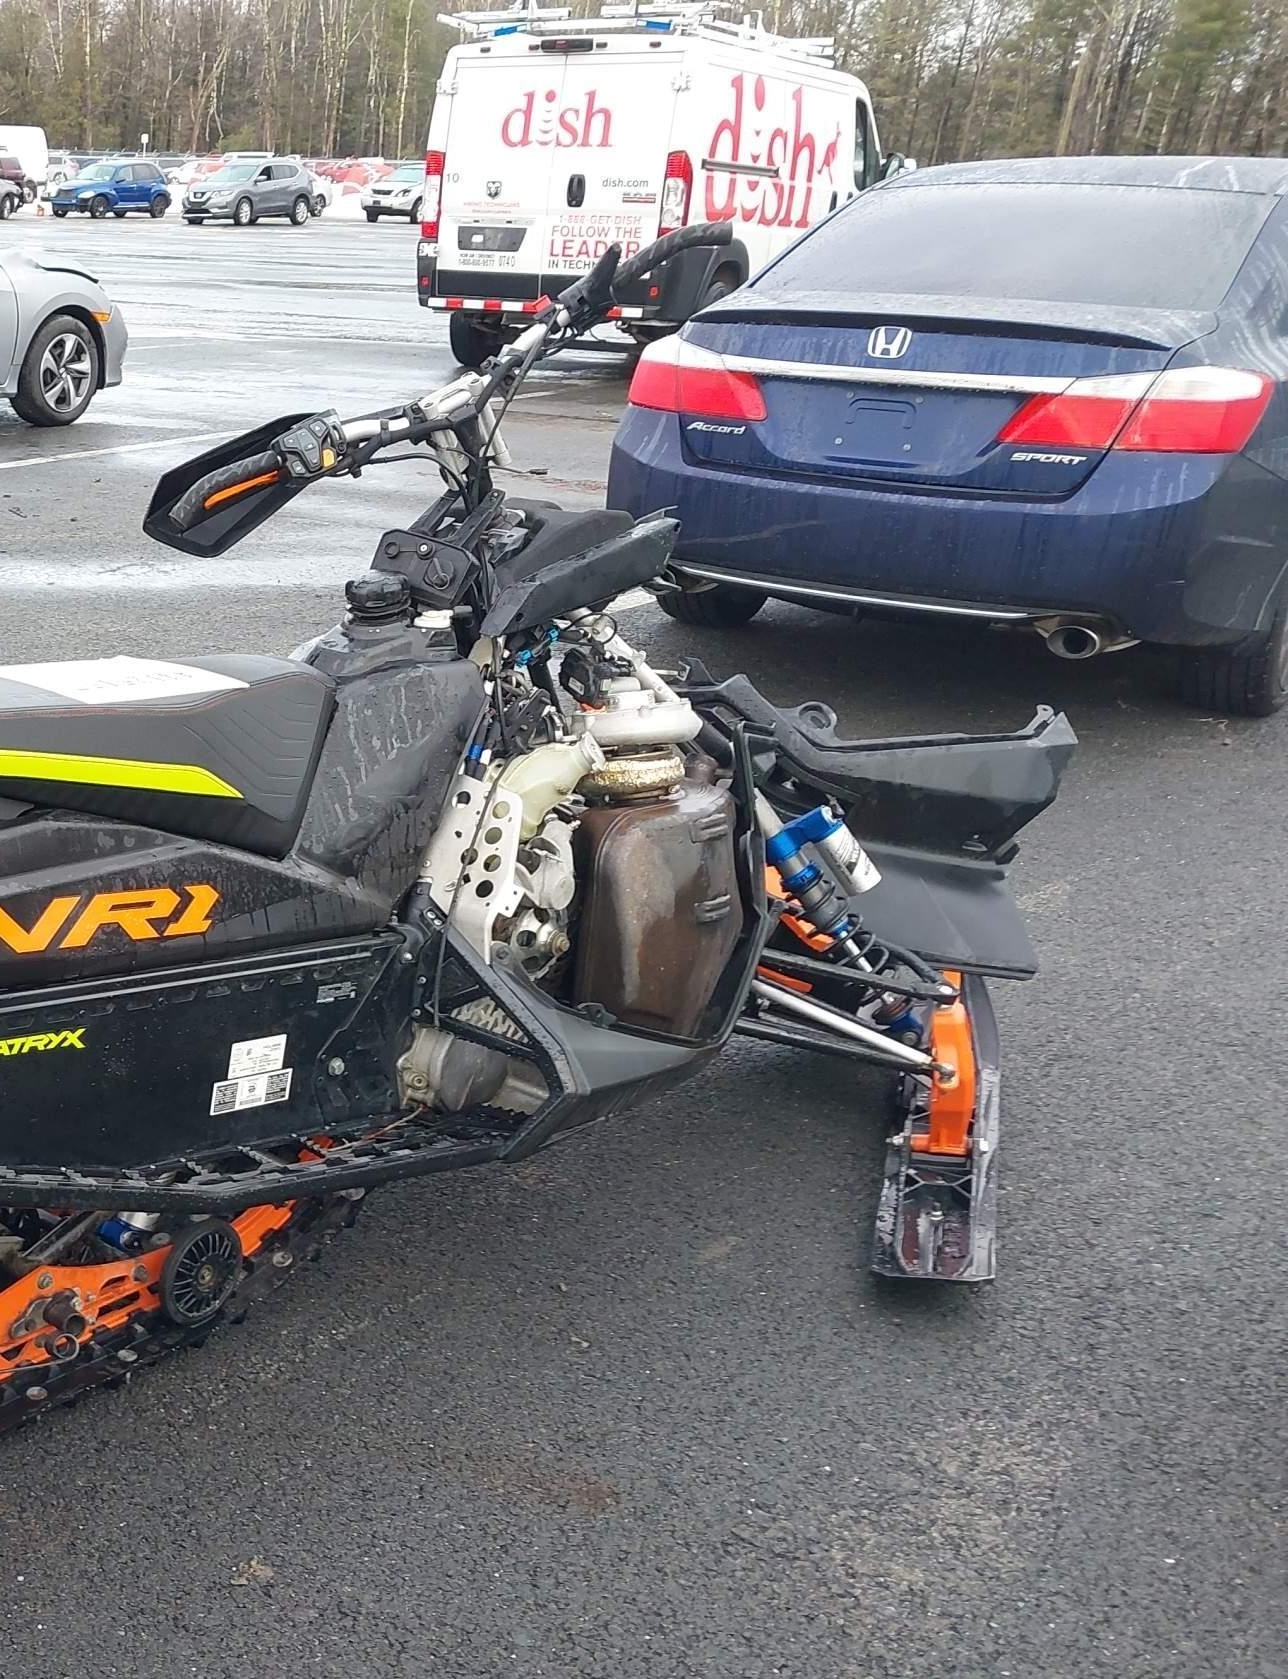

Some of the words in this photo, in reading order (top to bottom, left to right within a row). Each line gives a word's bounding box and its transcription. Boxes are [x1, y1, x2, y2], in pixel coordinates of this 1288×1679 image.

[501, 89, 613, 147] dish
[705, 72, 816, 228] dish
[602, 177, 649, 188] dish.com
[551, 225, 610, 238] FOLLOW
[615, 226, 642, 239] THE
[548, 239, 641, 259] LEADR
[547, 259, 559, 269] IN
[686, 421, 747, 435] Accord
[1010, 452, 1089, 465] SPORT
